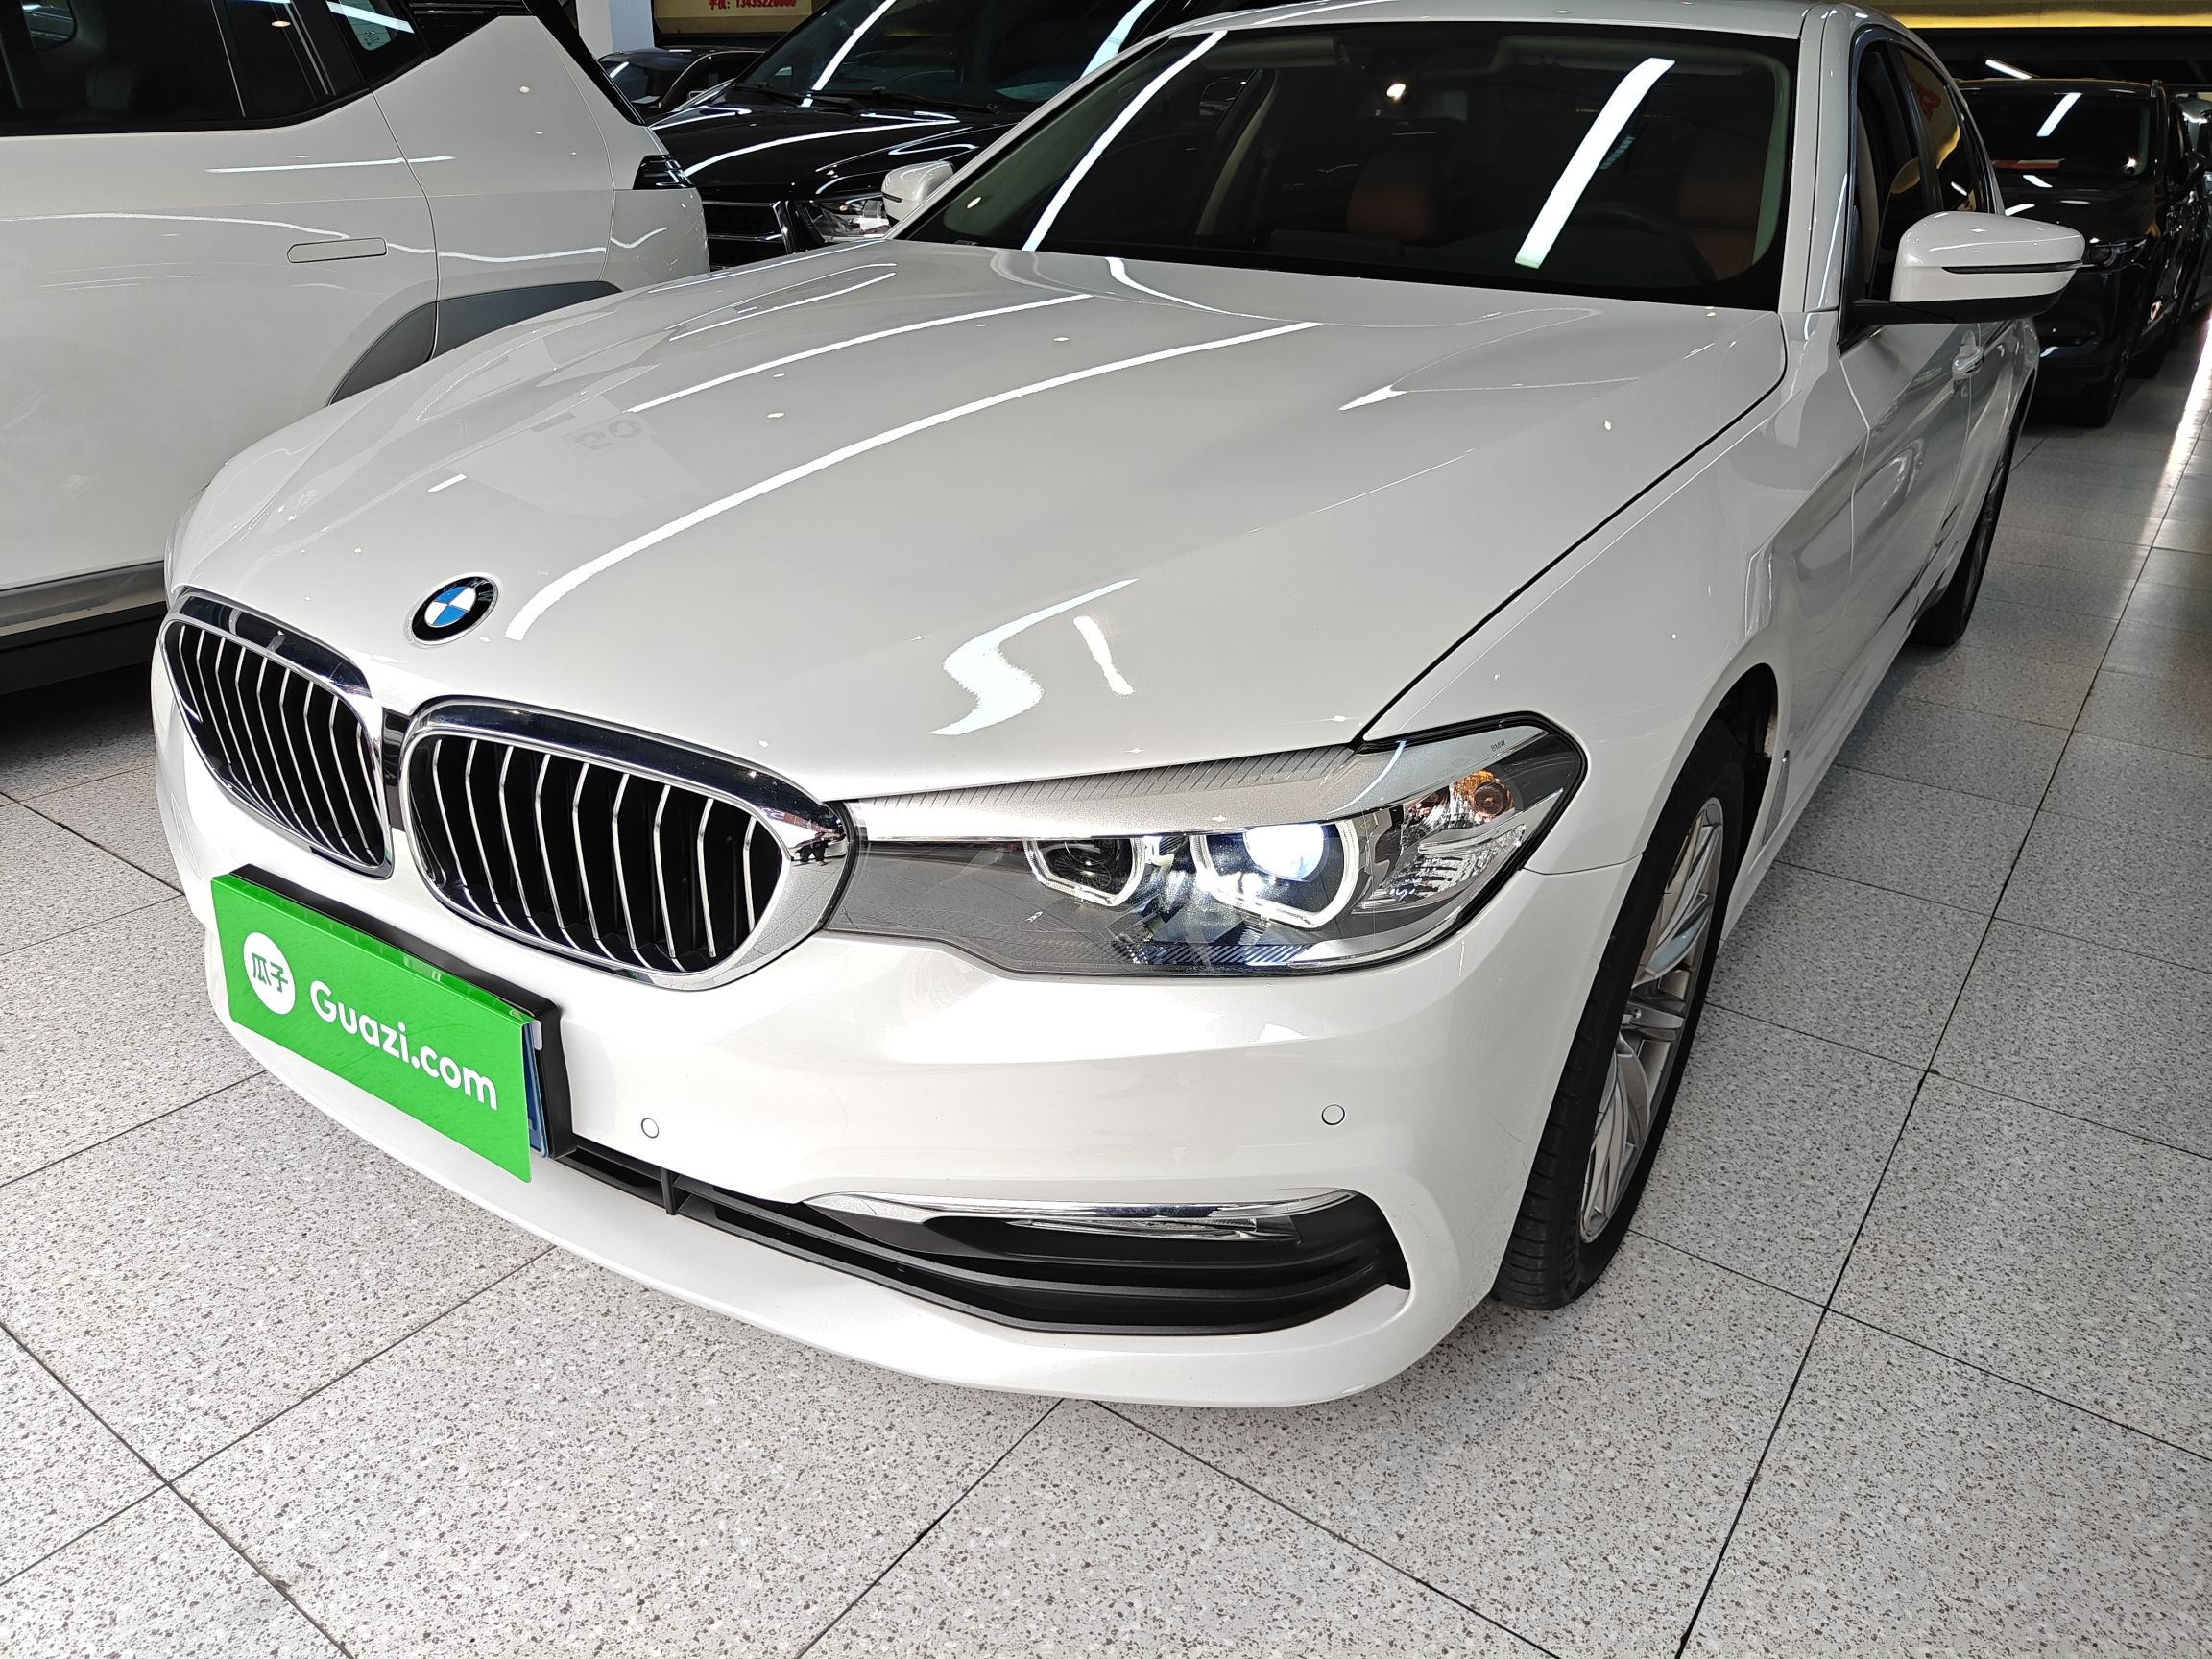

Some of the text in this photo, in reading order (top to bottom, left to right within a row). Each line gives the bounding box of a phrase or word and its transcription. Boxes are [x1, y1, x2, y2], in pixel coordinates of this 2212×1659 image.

[1490, 739, 1505, 752] BMW
[252, 952, 288, 993] 瓜子
[309, 980, 498, 1111] Guazi.com
